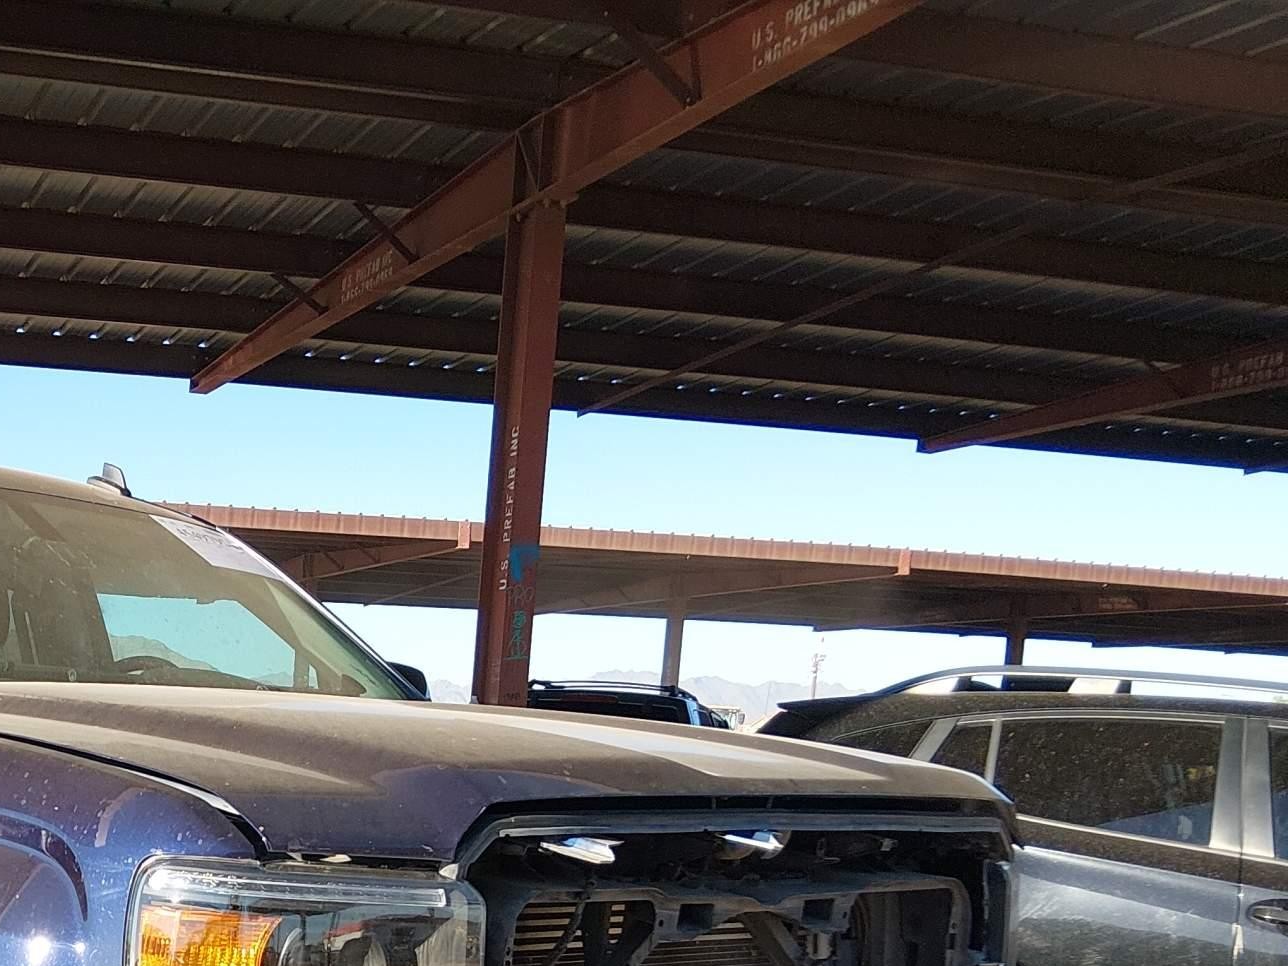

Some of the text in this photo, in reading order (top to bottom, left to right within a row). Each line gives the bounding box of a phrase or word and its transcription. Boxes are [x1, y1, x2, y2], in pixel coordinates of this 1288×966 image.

[751, 20, 778, 49] U.S.
[502, 466, 516, 543] PREFAB
[509, 424, 520, 457] INC
